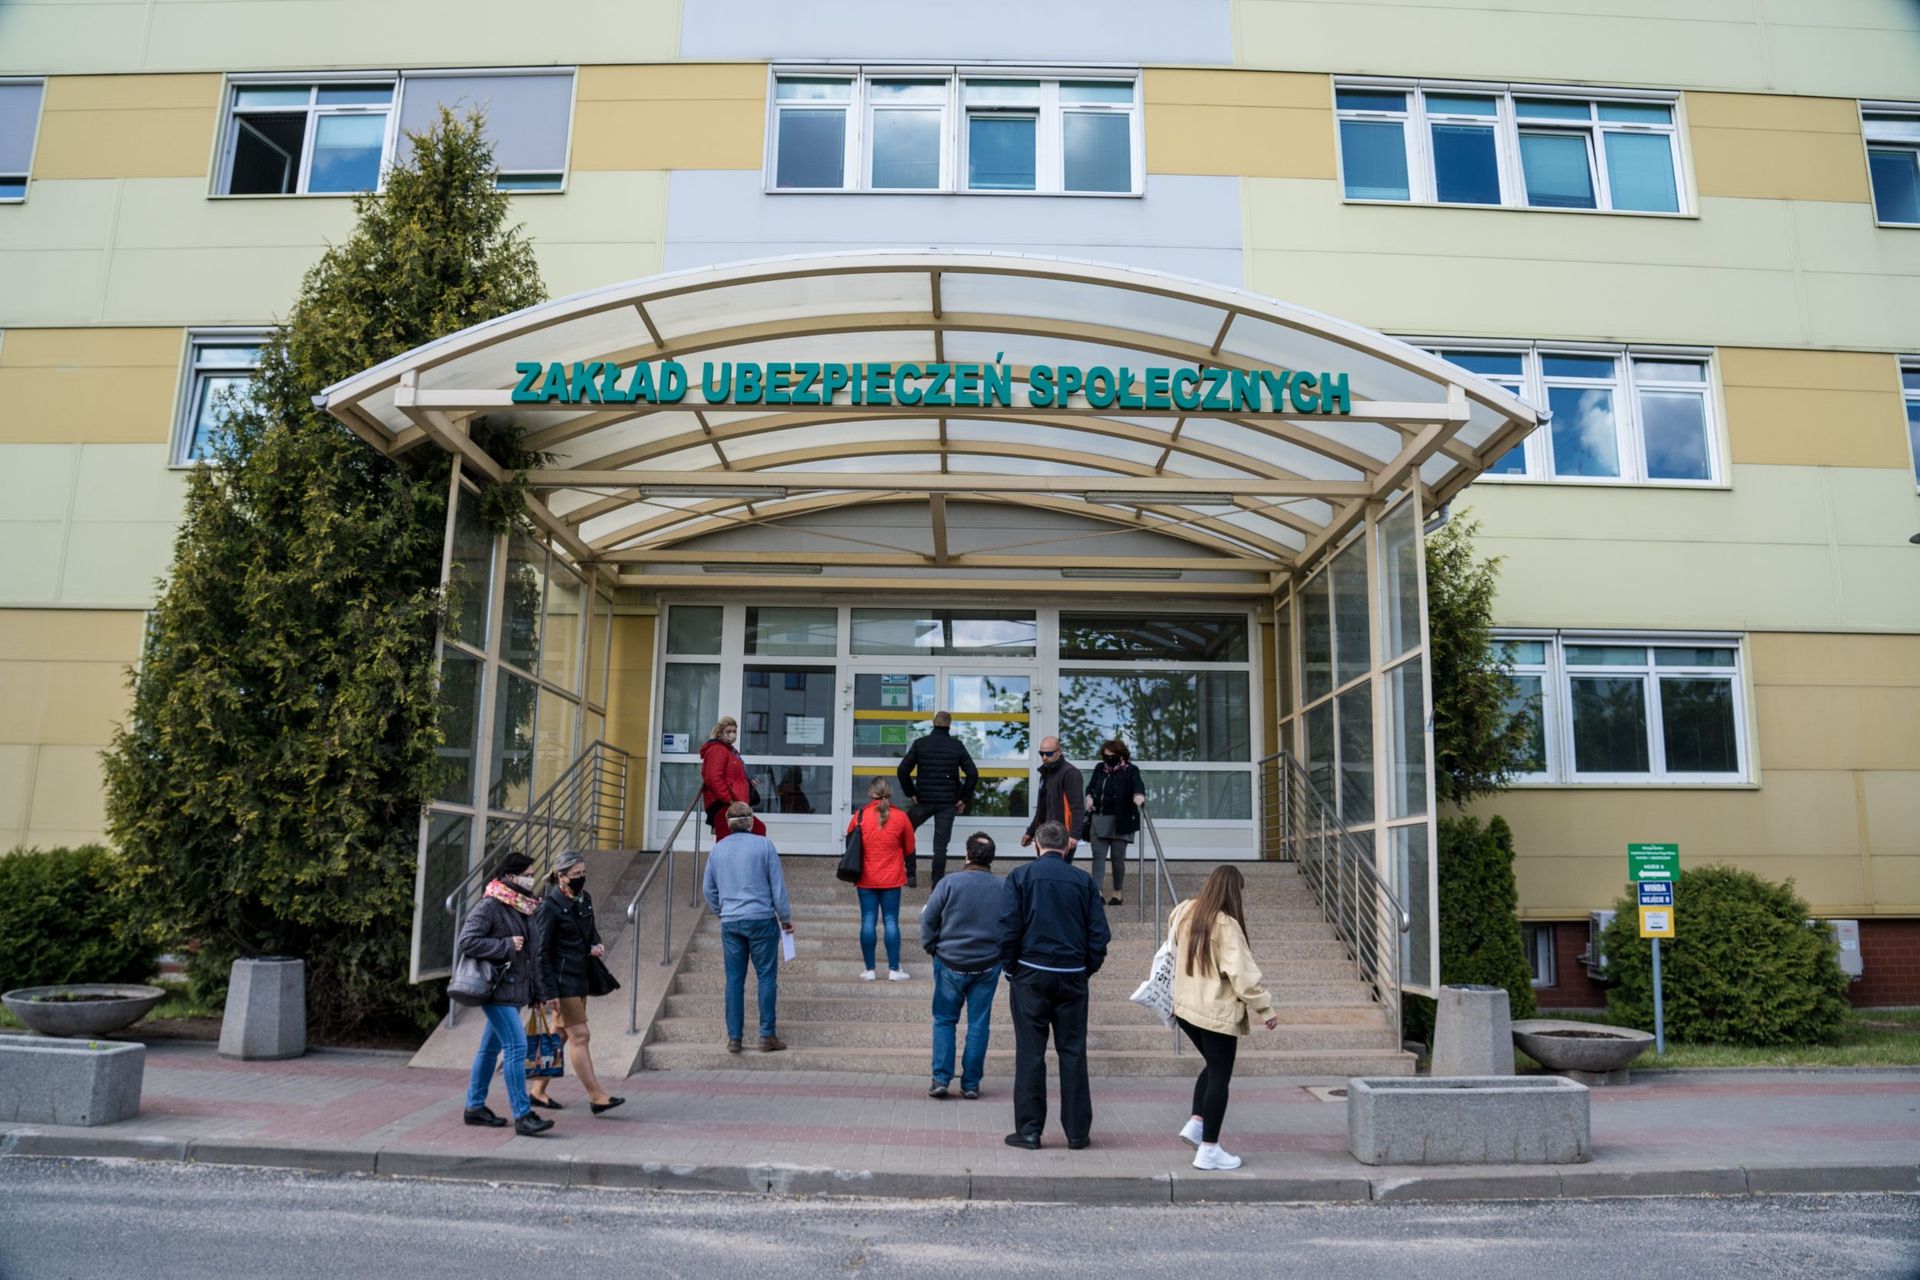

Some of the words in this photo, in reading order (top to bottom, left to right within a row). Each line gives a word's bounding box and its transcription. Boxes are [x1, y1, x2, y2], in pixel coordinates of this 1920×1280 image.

[511, 361, 689, 406] ZAKŁAD
[701, 351, 1013, 408] UBEZPIECZEŃ
[1028, 364, 1352, 416] SPOŁECZNYCH
